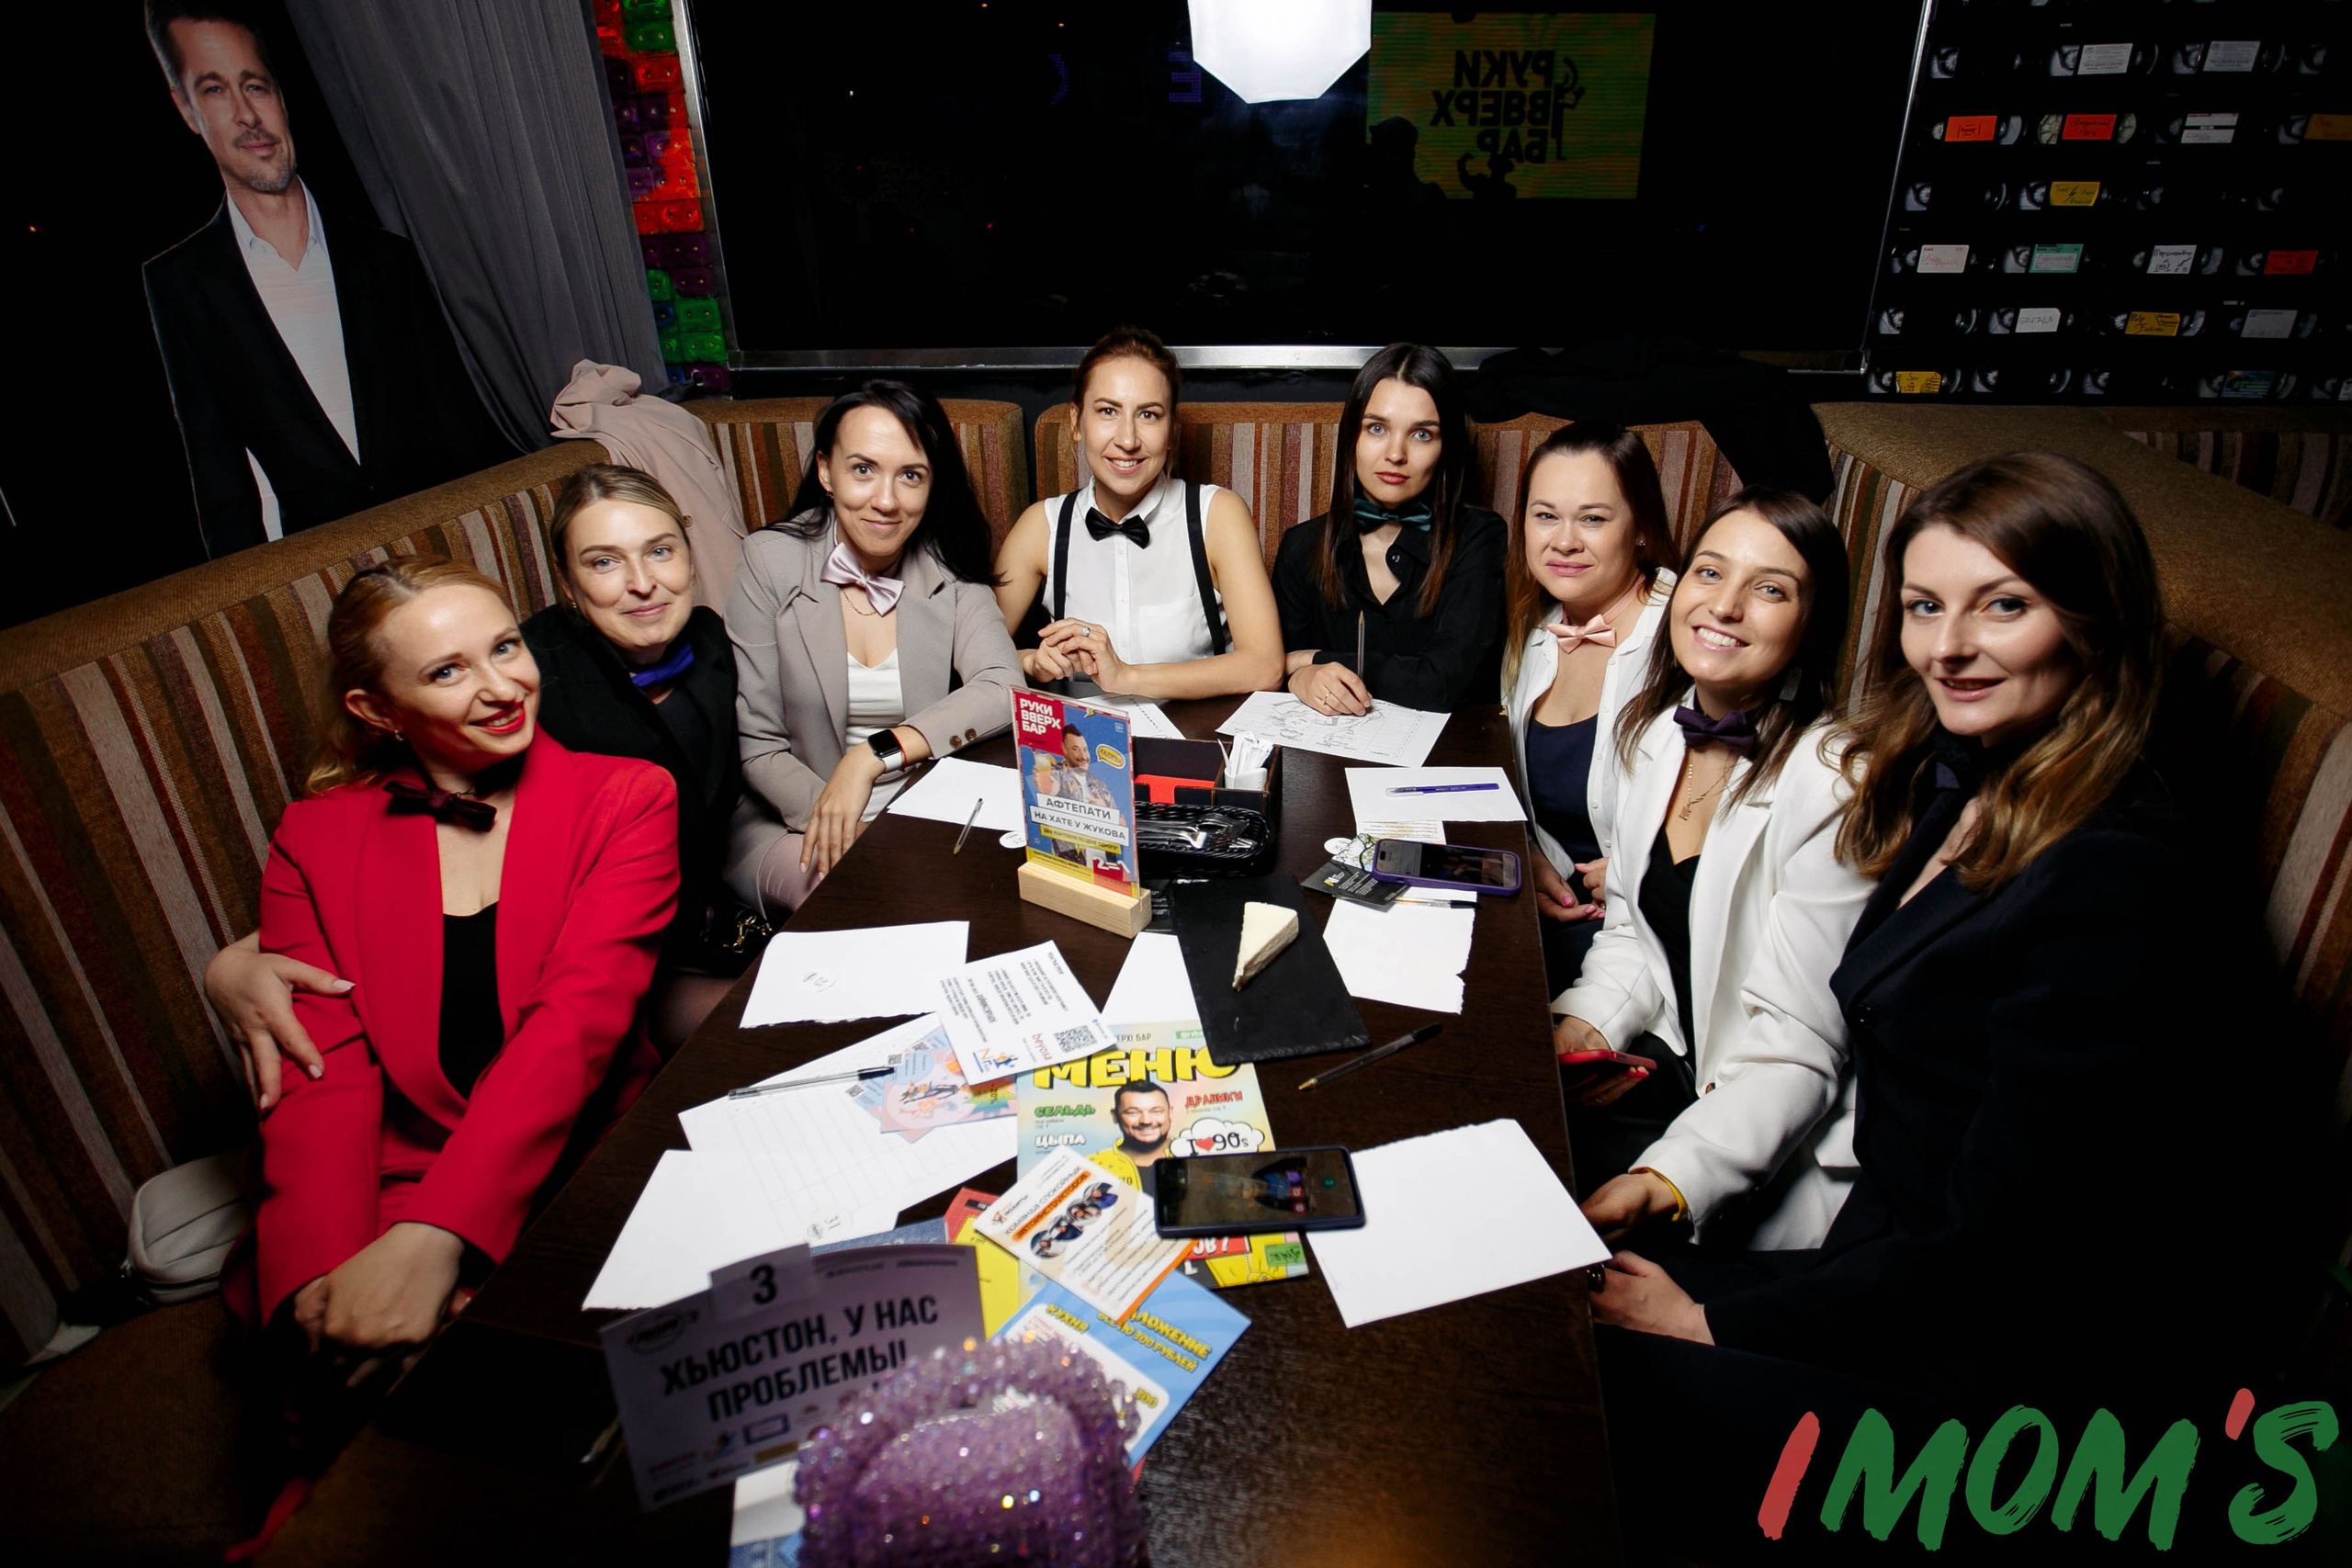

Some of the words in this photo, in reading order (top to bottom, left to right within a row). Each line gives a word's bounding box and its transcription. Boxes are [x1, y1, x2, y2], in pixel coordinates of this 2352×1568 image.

[1020, 698, 1053, 716] РУКИ
[1021, 710, 1061, 729] ВВЕРХ
[1022, 722, 1046, 735] БАР
[1046, 797, 1111, 820] АФТЕПАТИ
[1035, 811, 1047, 821] НА
[1049, 815, 1073, 827] ХАТЕ
[1075, 820, 1080, 829] У
[1082, 822, 1126, 840] ЖУКОВА
[1136, 1032, 1152, 1043] БАР
[1033, 1046, 1238, 1089] МЕНЮ
[1184, 1090, 1243, 1110] ДРАНИКИ
[1035, 1103, 1096, 1120] СЕЛЬДЬ
[1035, 1134, 1087, 1148] ЦЫПА
[749, 1264, 778, 1306] 3
[1046, 1303, 1090, 1334] КУХНЯ
[660, 1314, 838, 1396] ХЬЮСТОН,
[843, 1304, 865, 1337] У
[874, 1295, 939, 1331] НАС
[1154, 1342, 1199, 1373] РУБЛЕЙ
